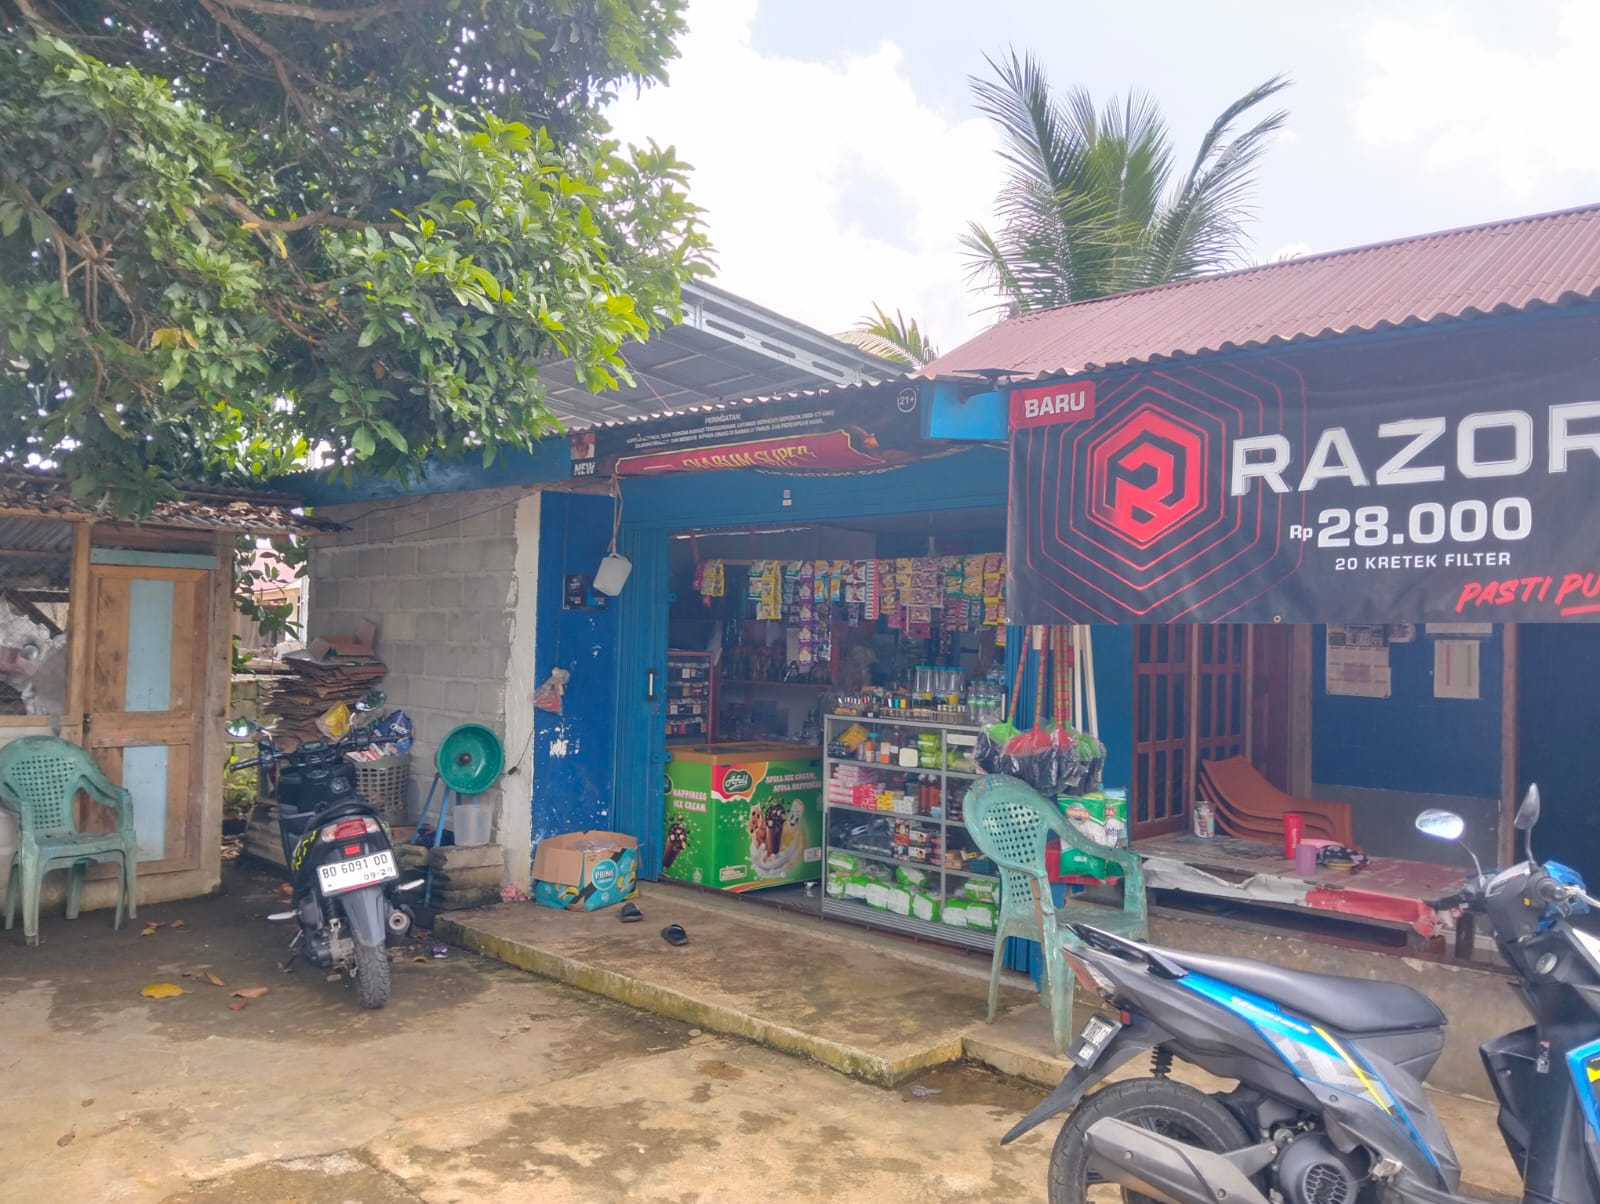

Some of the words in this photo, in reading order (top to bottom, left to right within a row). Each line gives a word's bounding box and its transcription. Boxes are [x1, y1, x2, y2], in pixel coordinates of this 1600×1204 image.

[899, 395, 915, 406] 21+
[1025, 391, 1085, 418] BARU
[574, 461, 596, 476] NEW
[1290, 525, 1313, 541] Rp
[1318, 497, 1532, 548] 28.000
[1335, 558, 1358, 571] 20
[1365, 555, 1437, 569] KRETEK
[1445, 552, 1511, 567] FILTER
[1455, 576, 1553, 614] PASTI
[672, 788, 707, 801] HAPPINESS
[673, 800, 684, 809] ICE
[685, 801, 706, 813] CREAM
[322, 866, 337, 879] BD
[341, 859, 369, 874] 6091
